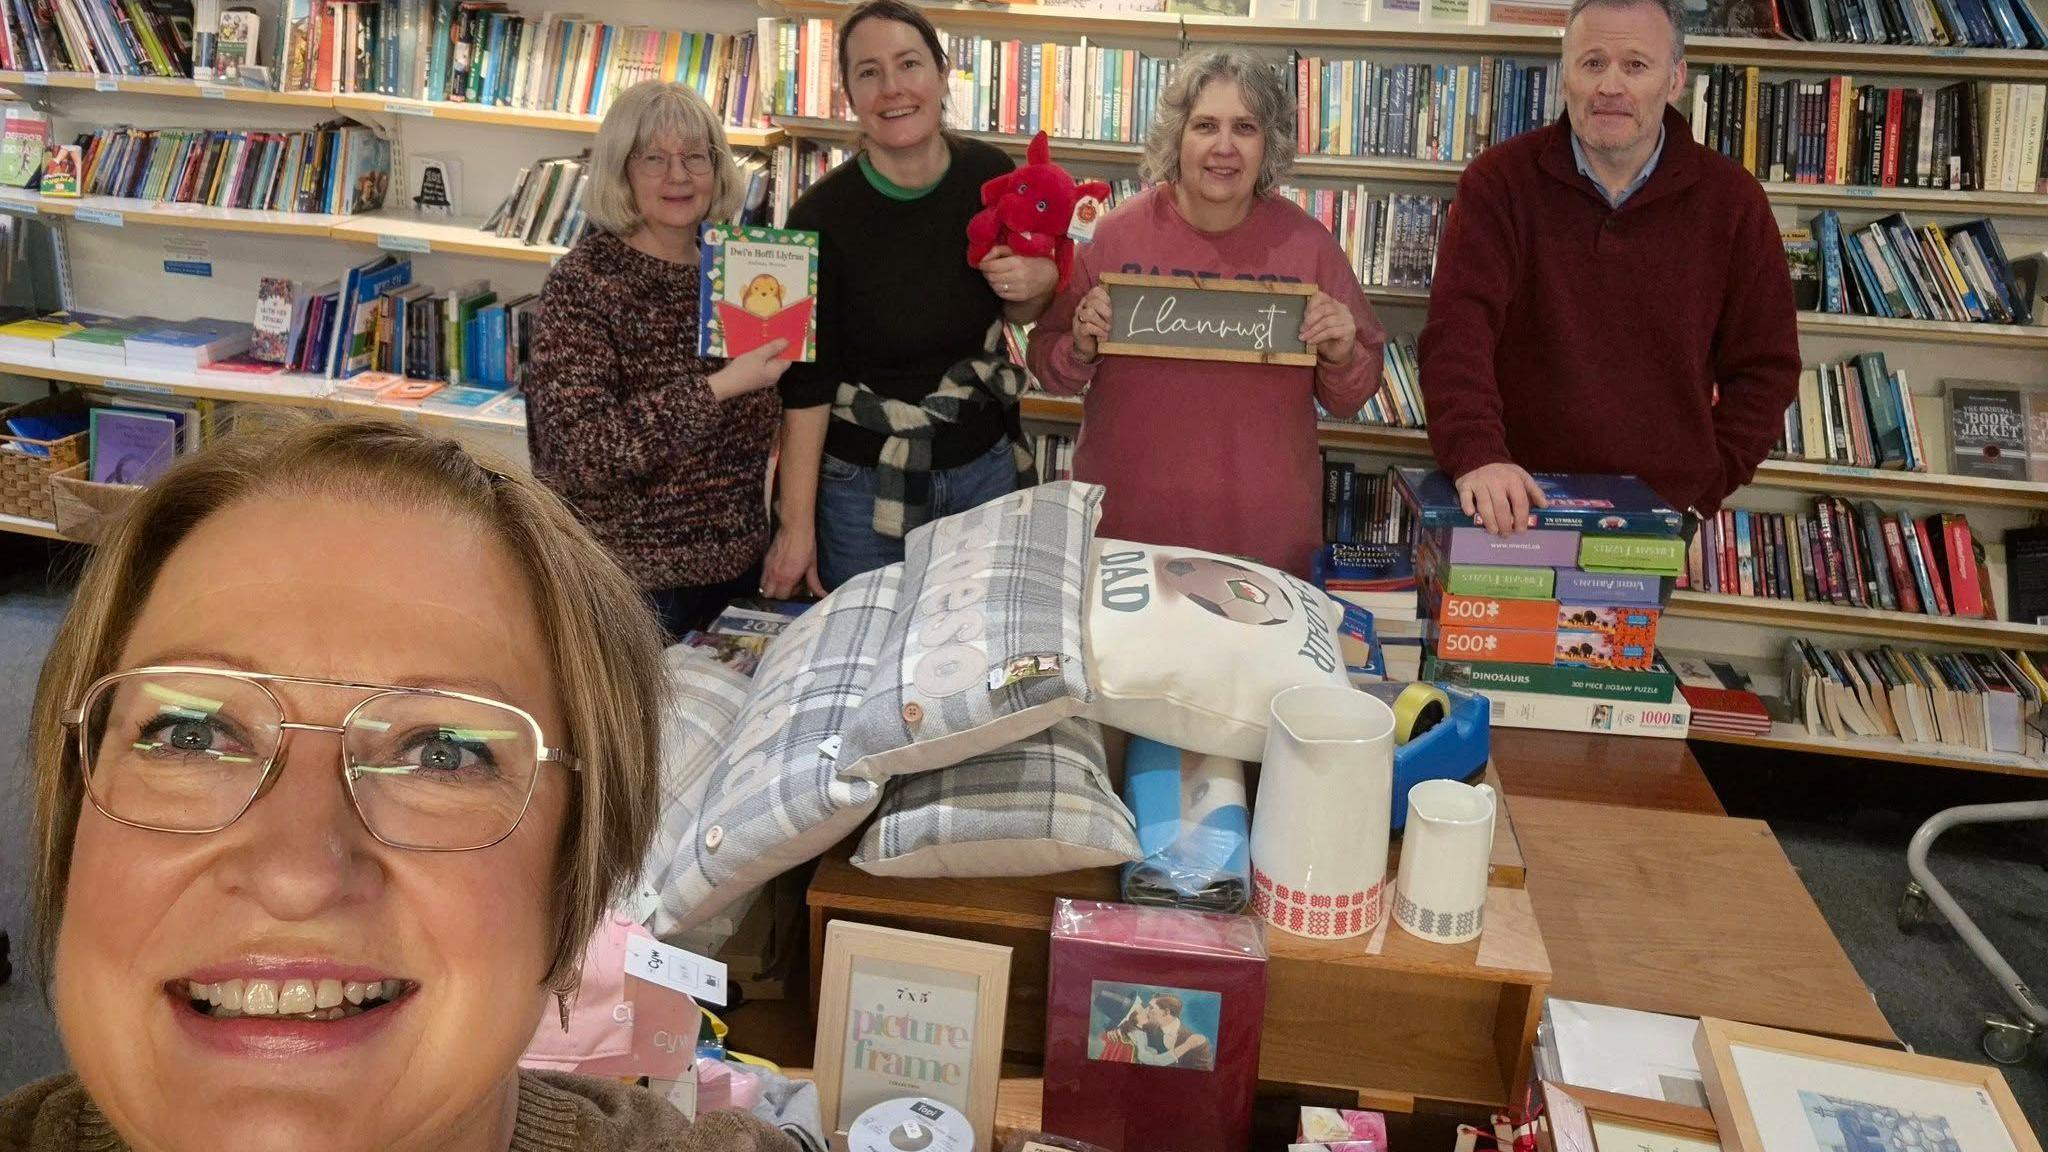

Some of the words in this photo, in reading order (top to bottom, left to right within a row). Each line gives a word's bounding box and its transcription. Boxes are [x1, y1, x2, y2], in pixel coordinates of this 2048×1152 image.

[730, 247, 753, 257] Dwi'n
[755, 249, 775, 259] Hoffi
[1127, 295, 1287, 350] Llanrwst
[1979, 406, 2014, 415] ORIGINAL
[1969, 412, 2011, 426] BOOK
[1962, 423, 2019, 438] JACKET
[1818, 503, 1832, 538] DIGNITY
[1332, 543, 1387, 552] Oxford
[1333, 555, 1397, 563] German
[1100, 551, 1150, 612] DAD
[1447, 600, 1486, 617] 500
[1446, 634, 1485, 652] 500
[1472, 671, 1530, 684] DINOSAURS
[1585, 682, 1603, 690] PIECE
[1605, 683, 1632, 692] JIGSAW
[1634, 685, 1659, 694] PUZZLE
[1640, 710, 1671, 725] 1000
[648, 949, 664, 970] Cyw
[852, 1003, 969, 1049] picture
[854, 1038, 961, 1087] frame
